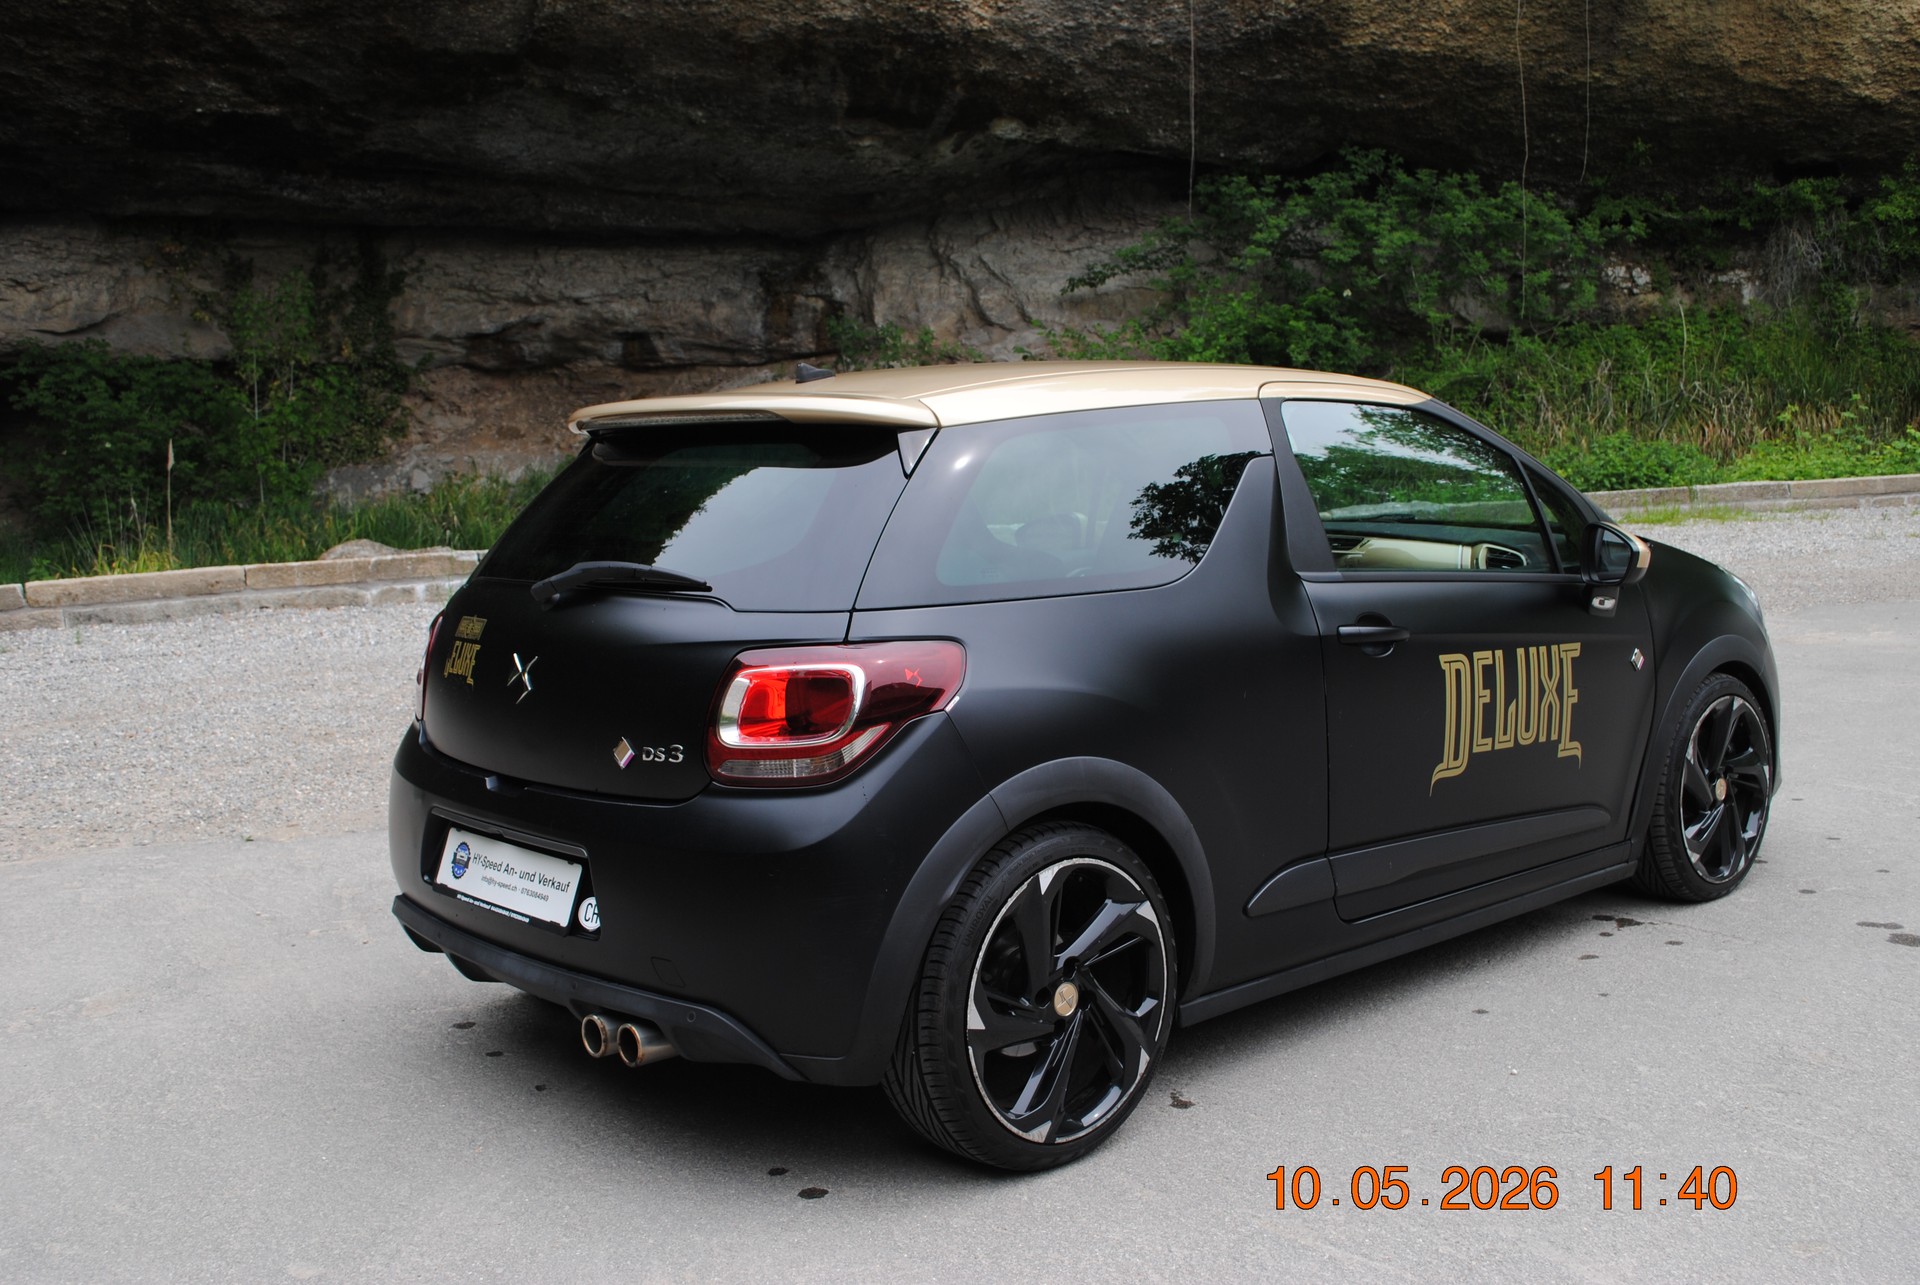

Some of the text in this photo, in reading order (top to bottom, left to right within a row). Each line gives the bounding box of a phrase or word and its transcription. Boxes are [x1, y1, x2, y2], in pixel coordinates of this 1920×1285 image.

[1429, 642, 1582, 797] DELUXE
[503, 863, 517, 876] An-
[519, 870, 537, 882] und
[538, 872, 571, 893] Verkauf
